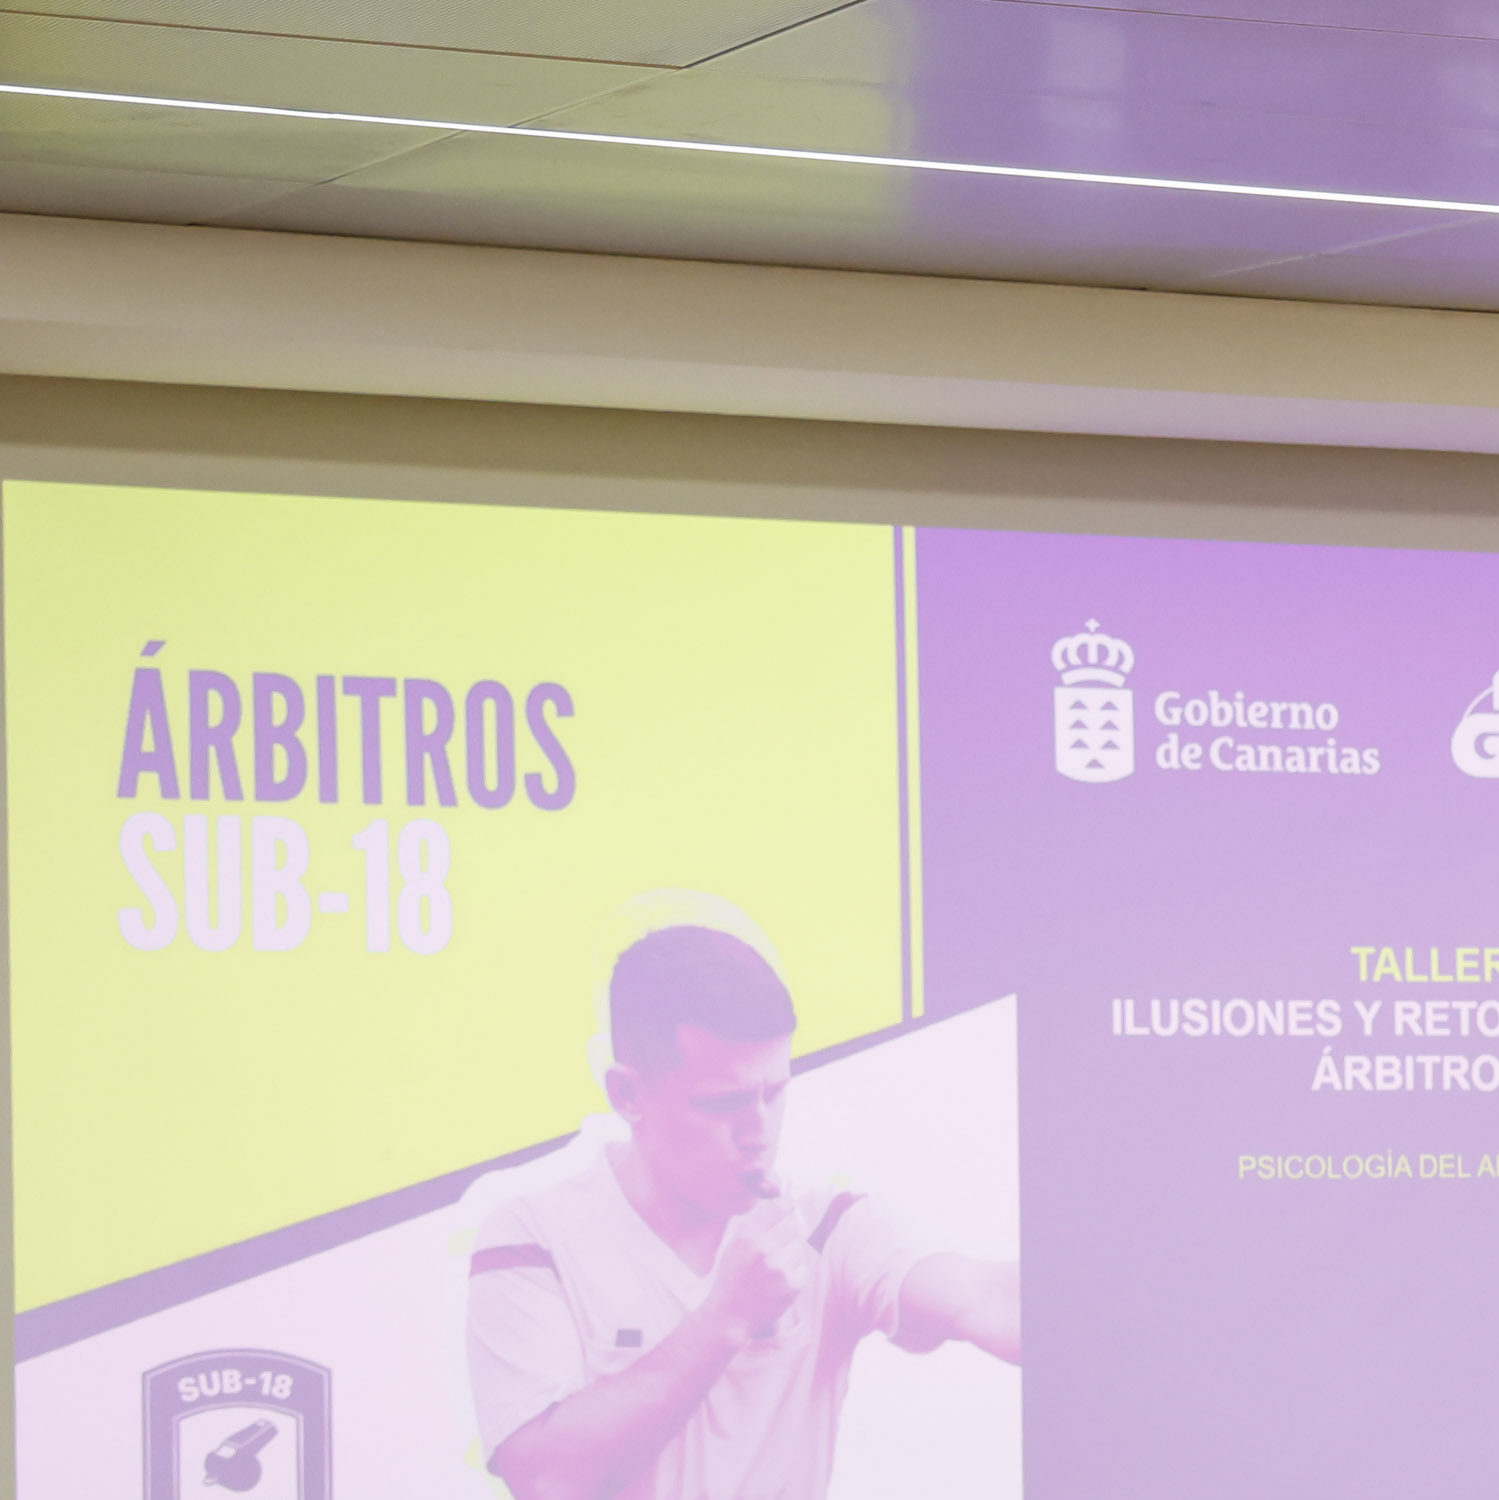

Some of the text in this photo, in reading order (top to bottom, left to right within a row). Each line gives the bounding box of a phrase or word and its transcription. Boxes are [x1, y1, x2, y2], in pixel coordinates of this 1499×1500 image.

[116, 640, 577, 811] ÁRBITROS
[1154, 690, 1339, 732] Gobierno
[1155, 733, 1381, 776] de Canarias
[117, 812, 453, 954] SUB-18
[1111, 999, 1343, 1038] ILUSIONES
[1352, 1001, 1382, 1036] Y
[1238, 1149, 1413, 1180] PSICOLOGÍA
[1419, 1154, 1471, 1179] DEL
[177, 1368, 294, 1402] SUB-18
